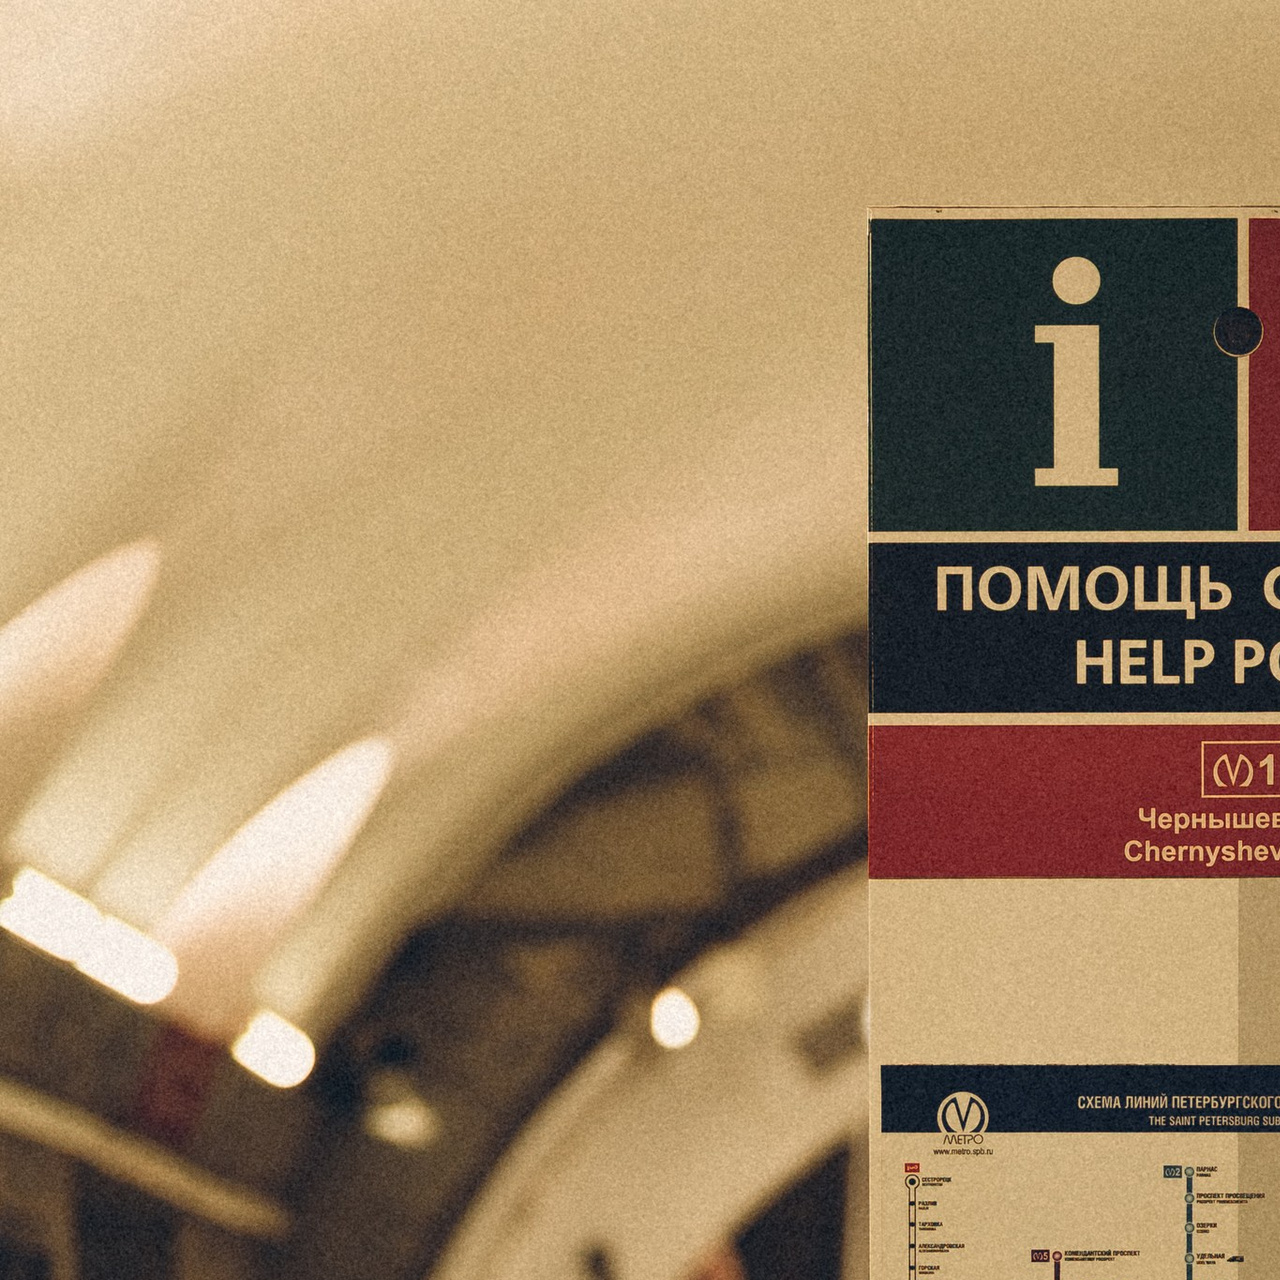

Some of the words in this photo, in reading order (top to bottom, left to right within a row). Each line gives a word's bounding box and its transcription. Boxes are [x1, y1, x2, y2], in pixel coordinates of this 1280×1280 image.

[936, 564, 1231, 619] ПОМОЩЬ
[1076, 638, 1214, 684] HELP
[1076, 1096, 1120, 1110] СХЕМА
[1126, 1092, 1167, 1110] ЛИНИЙ
[1148, 1116, 1166, 1126] THE
[1170, 1116, 1196, 1126] SAINT
[1198, 1116, 1260, 1126] PETERSBURG
[933, 1148, 994, 1156] www.metro.spb.ru
